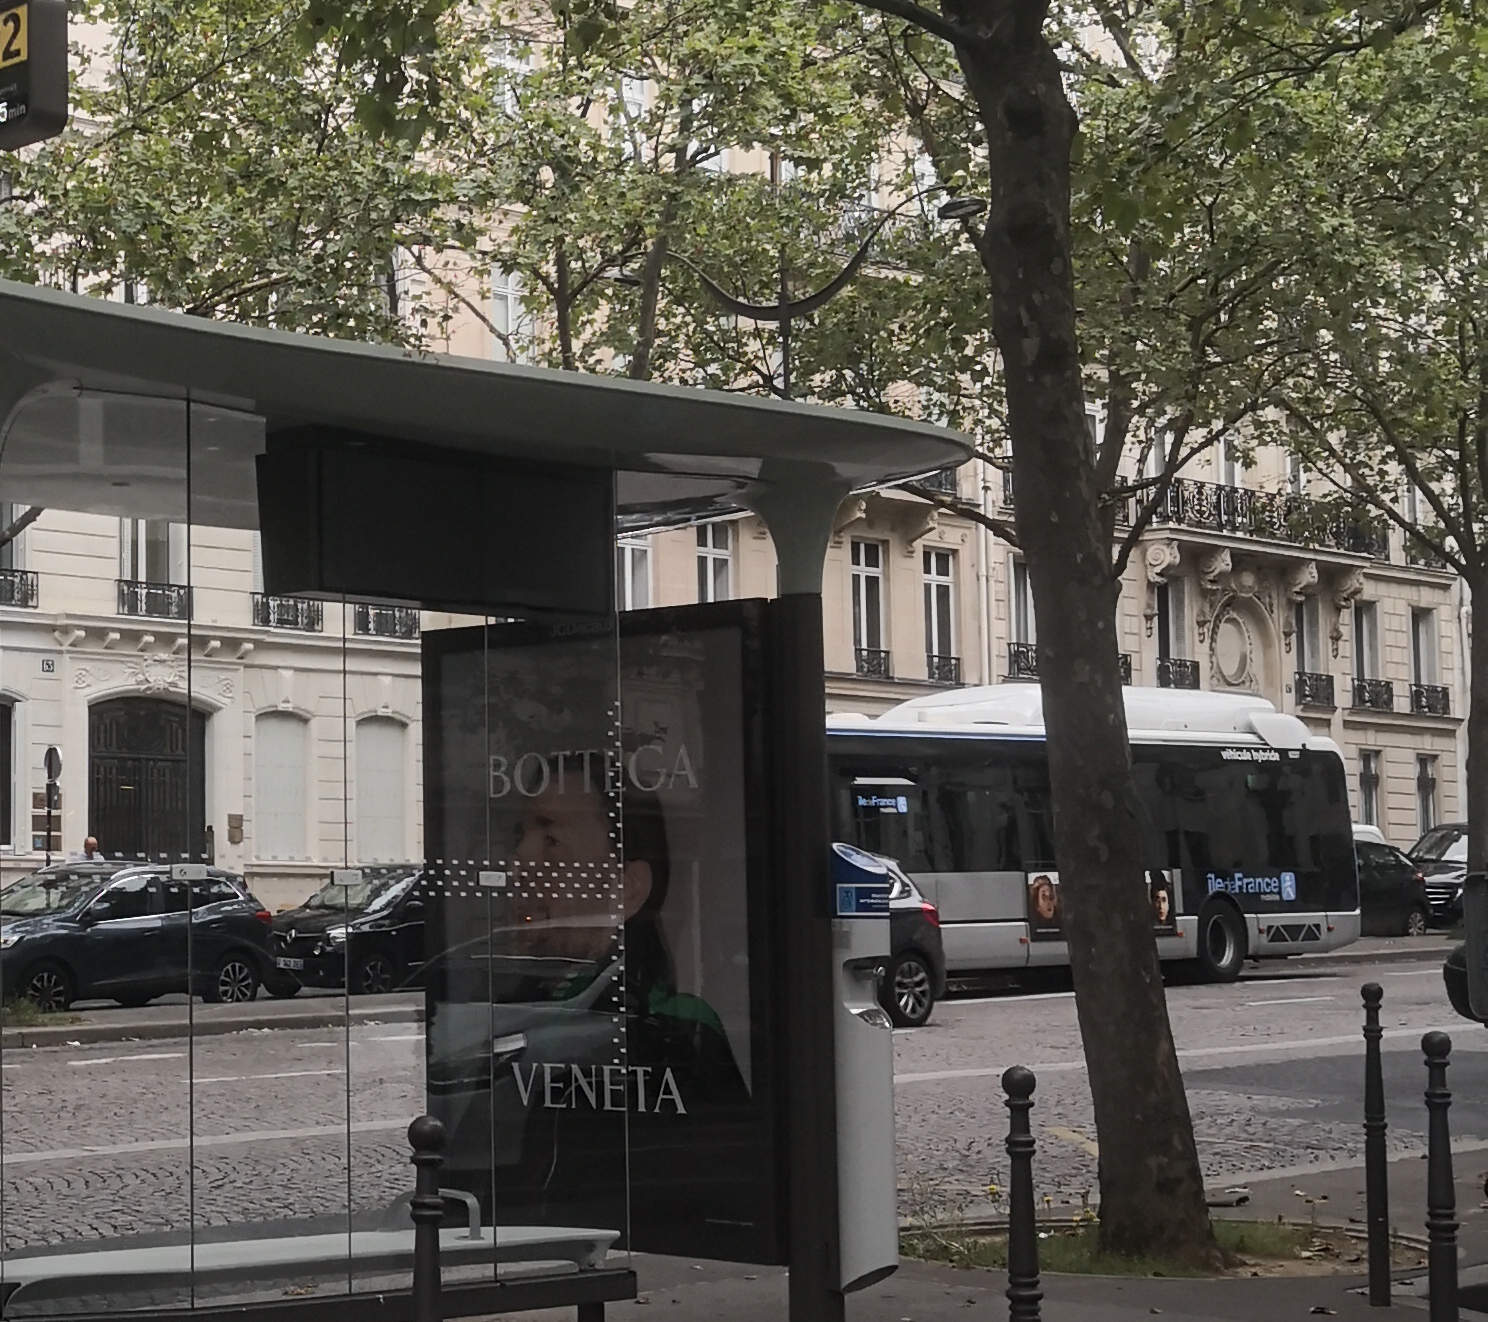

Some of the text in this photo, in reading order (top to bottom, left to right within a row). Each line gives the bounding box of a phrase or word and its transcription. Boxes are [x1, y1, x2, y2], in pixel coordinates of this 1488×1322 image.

[8, 103, 26, 120] min
[489, 743, 699, 799] BOTTEGA
[511, 1061, 688, 1115] VENETA
